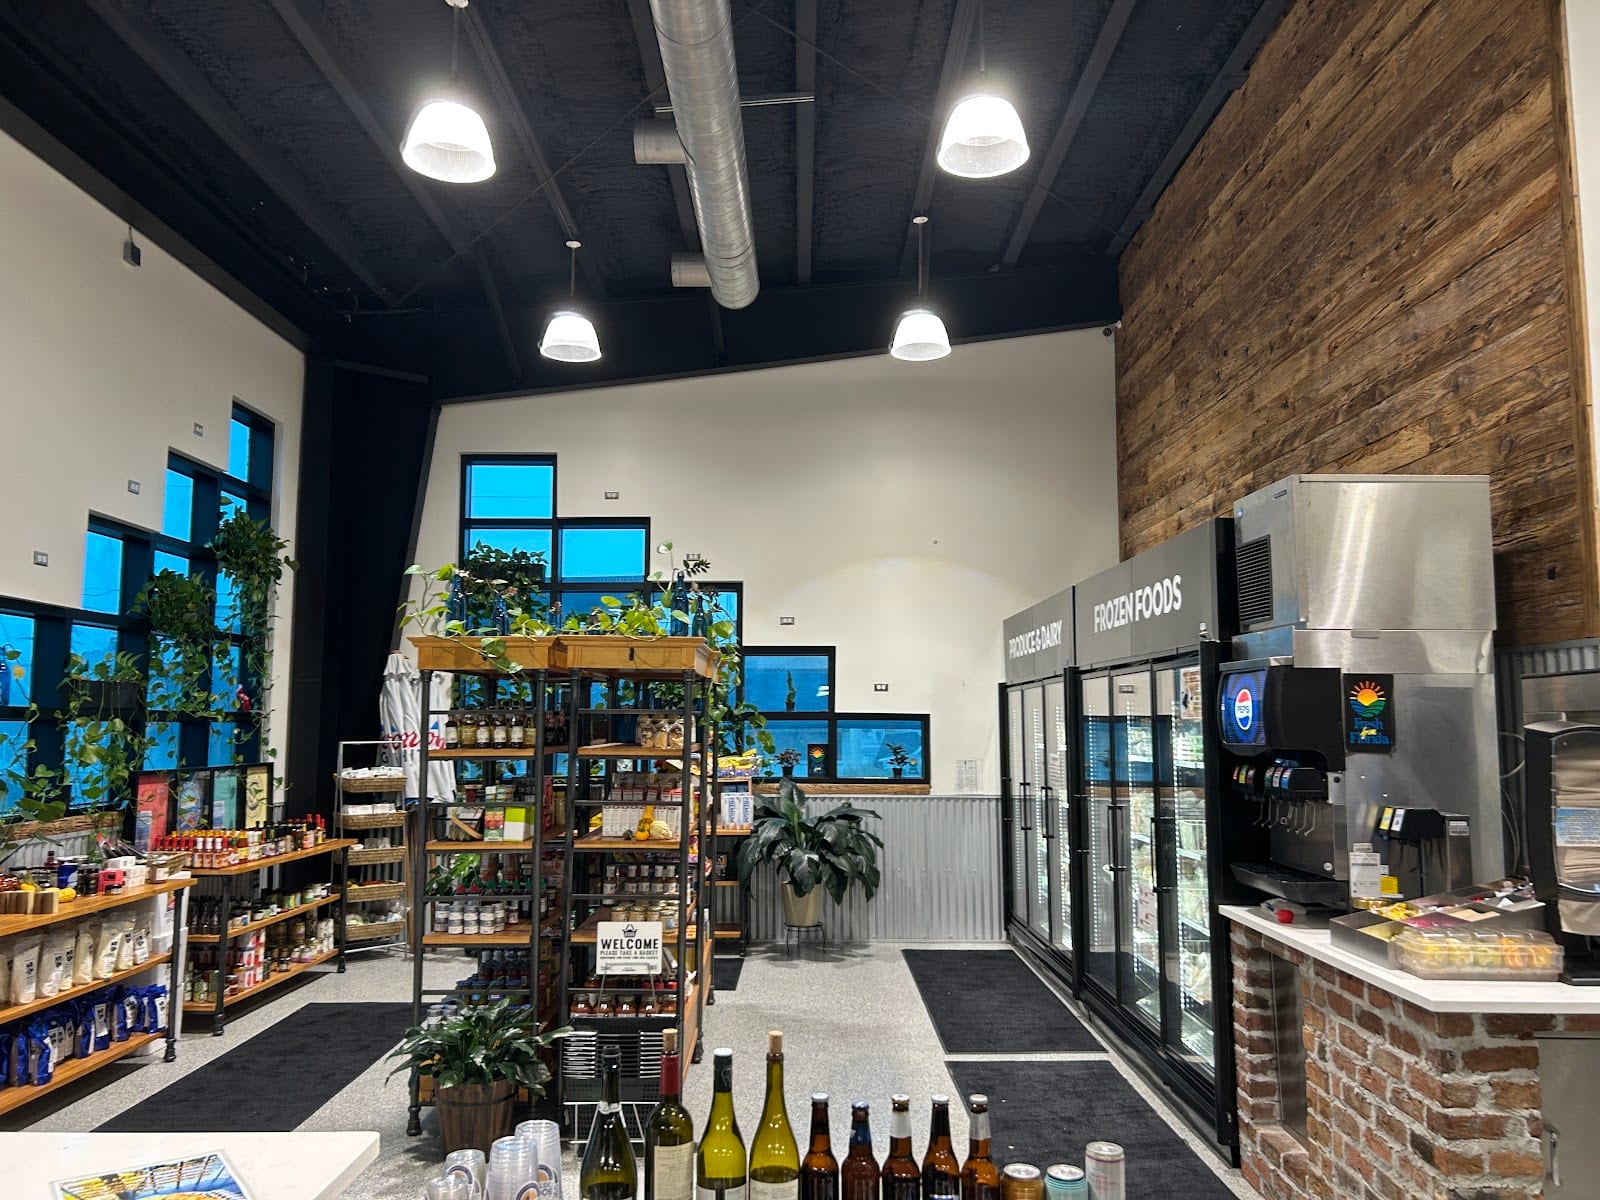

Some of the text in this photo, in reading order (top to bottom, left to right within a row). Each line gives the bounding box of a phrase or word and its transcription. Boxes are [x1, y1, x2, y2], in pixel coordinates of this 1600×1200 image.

[1094, 575, 1182, 633] FROZEN FOODS
[1009, 620, 1063, 660] PRODUCE & DAIRY
[1353, 717, 1383, 729] Fresh
[1349, 731, 1390, 744] Florida
[601, 939, 659, 949] WELCOME
